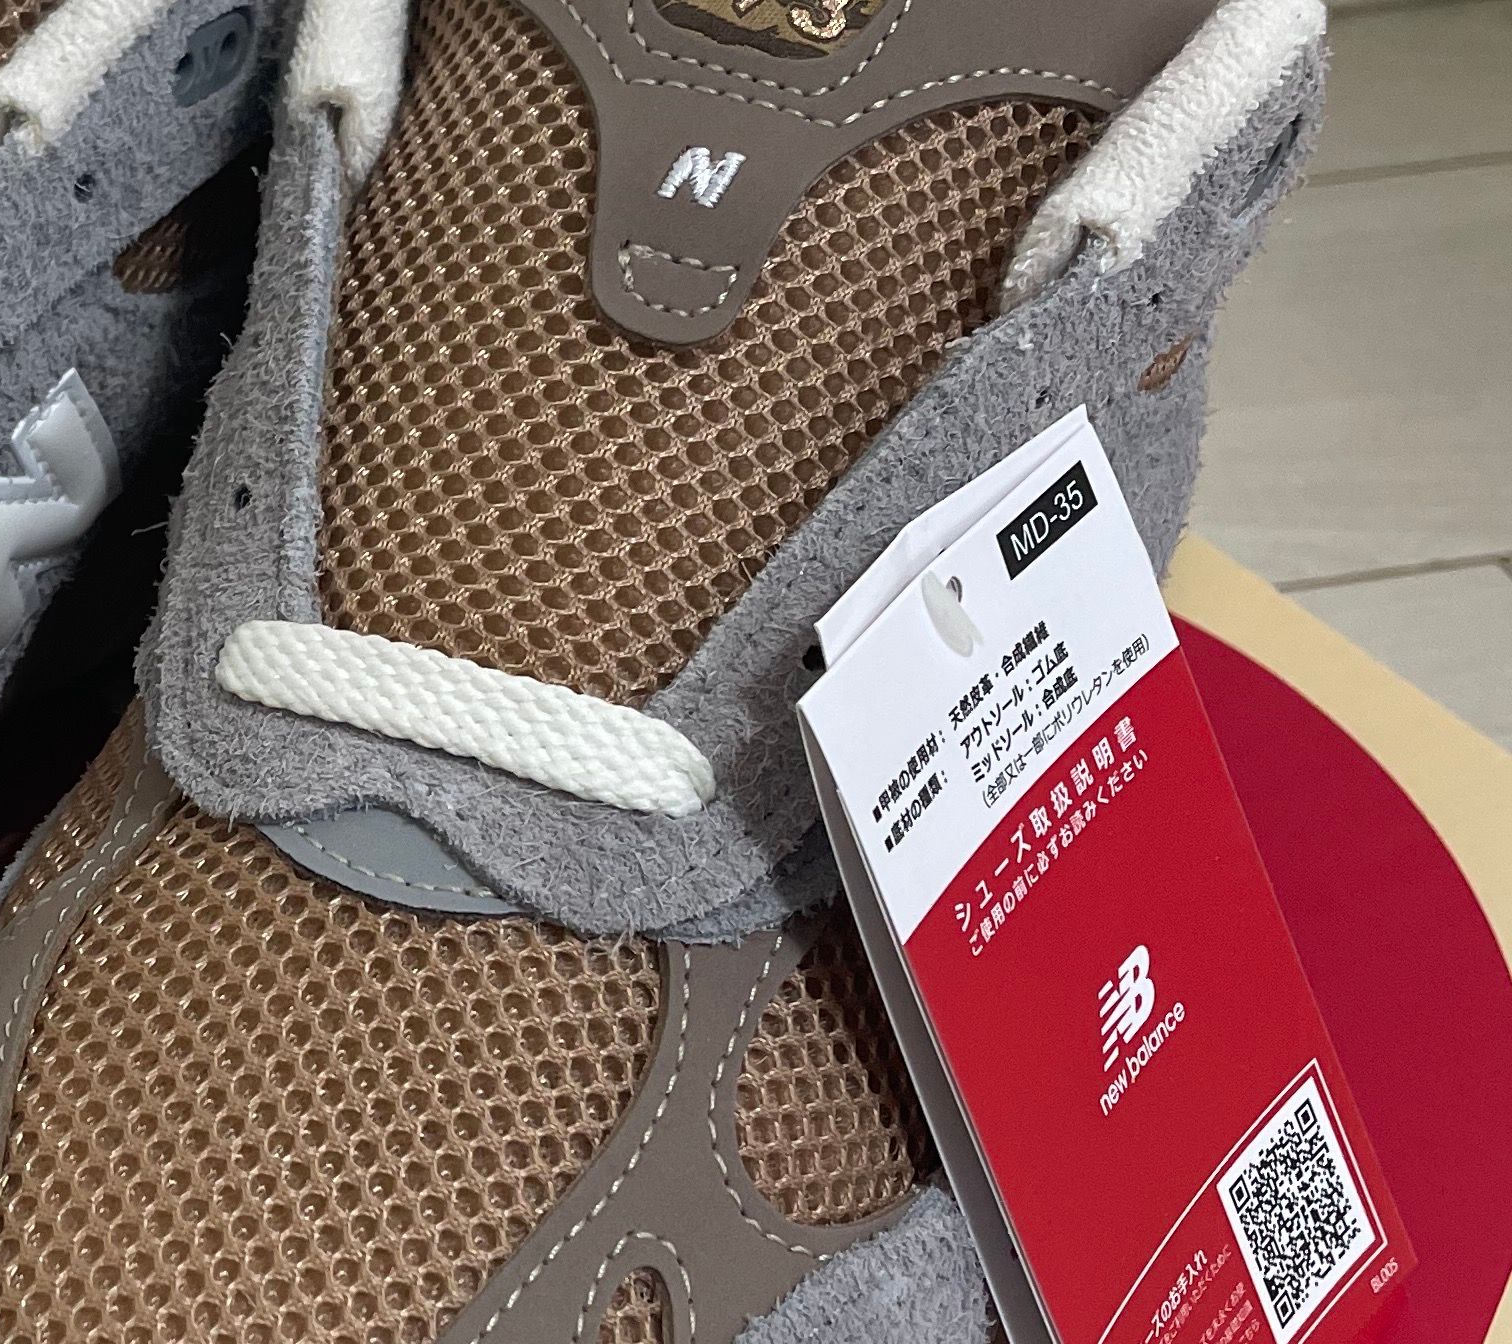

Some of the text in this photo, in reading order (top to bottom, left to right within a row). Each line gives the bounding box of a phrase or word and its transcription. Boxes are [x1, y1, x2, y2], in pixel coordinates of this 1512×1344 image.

[658, 146, 747, 208] N
[1010, 479, 1084, 561] MD-35
[954, 716, 1137, 932] シューズ取扱説明書
[969, 749, 1149, 957] ご使用の前に必ずお読みください
[1099, 1002, 1185, 1117] new balance
